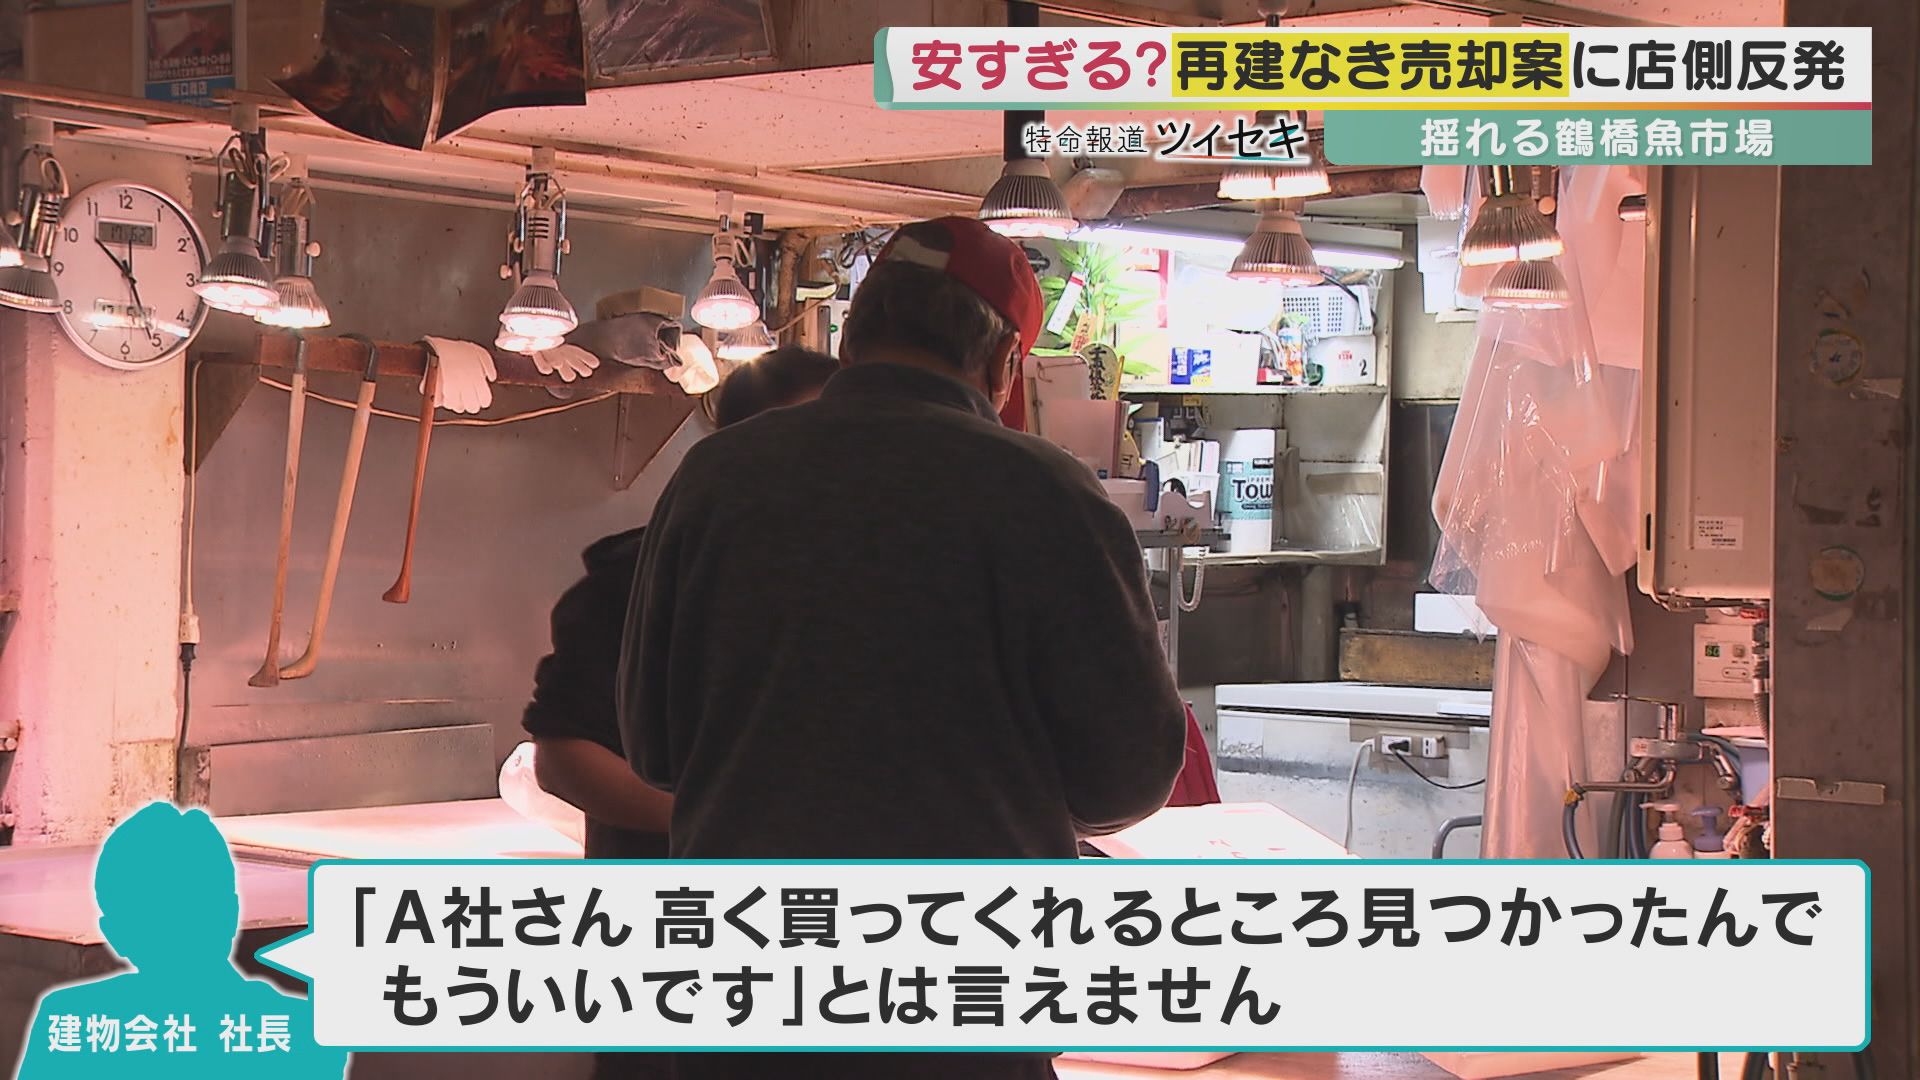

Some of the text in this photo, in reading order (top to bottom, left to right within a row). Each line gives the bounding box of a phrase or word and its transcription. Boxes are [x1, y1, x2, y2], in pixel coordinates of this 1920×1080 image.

[119, 195, 133, 209] 12
[64, 228, 79, 242] 10
[177, 239, 187, 252] 2
[53, 262, 65, 276] 9
[186, 273, 196, 287] 3
[64, 300, 73, 314] 8
[176, 309, 185, 322] 4
[152, 334, 162, 347] 5
[120, 341, 131, 355] 6
[1359, 359, 1368, 377] 2
